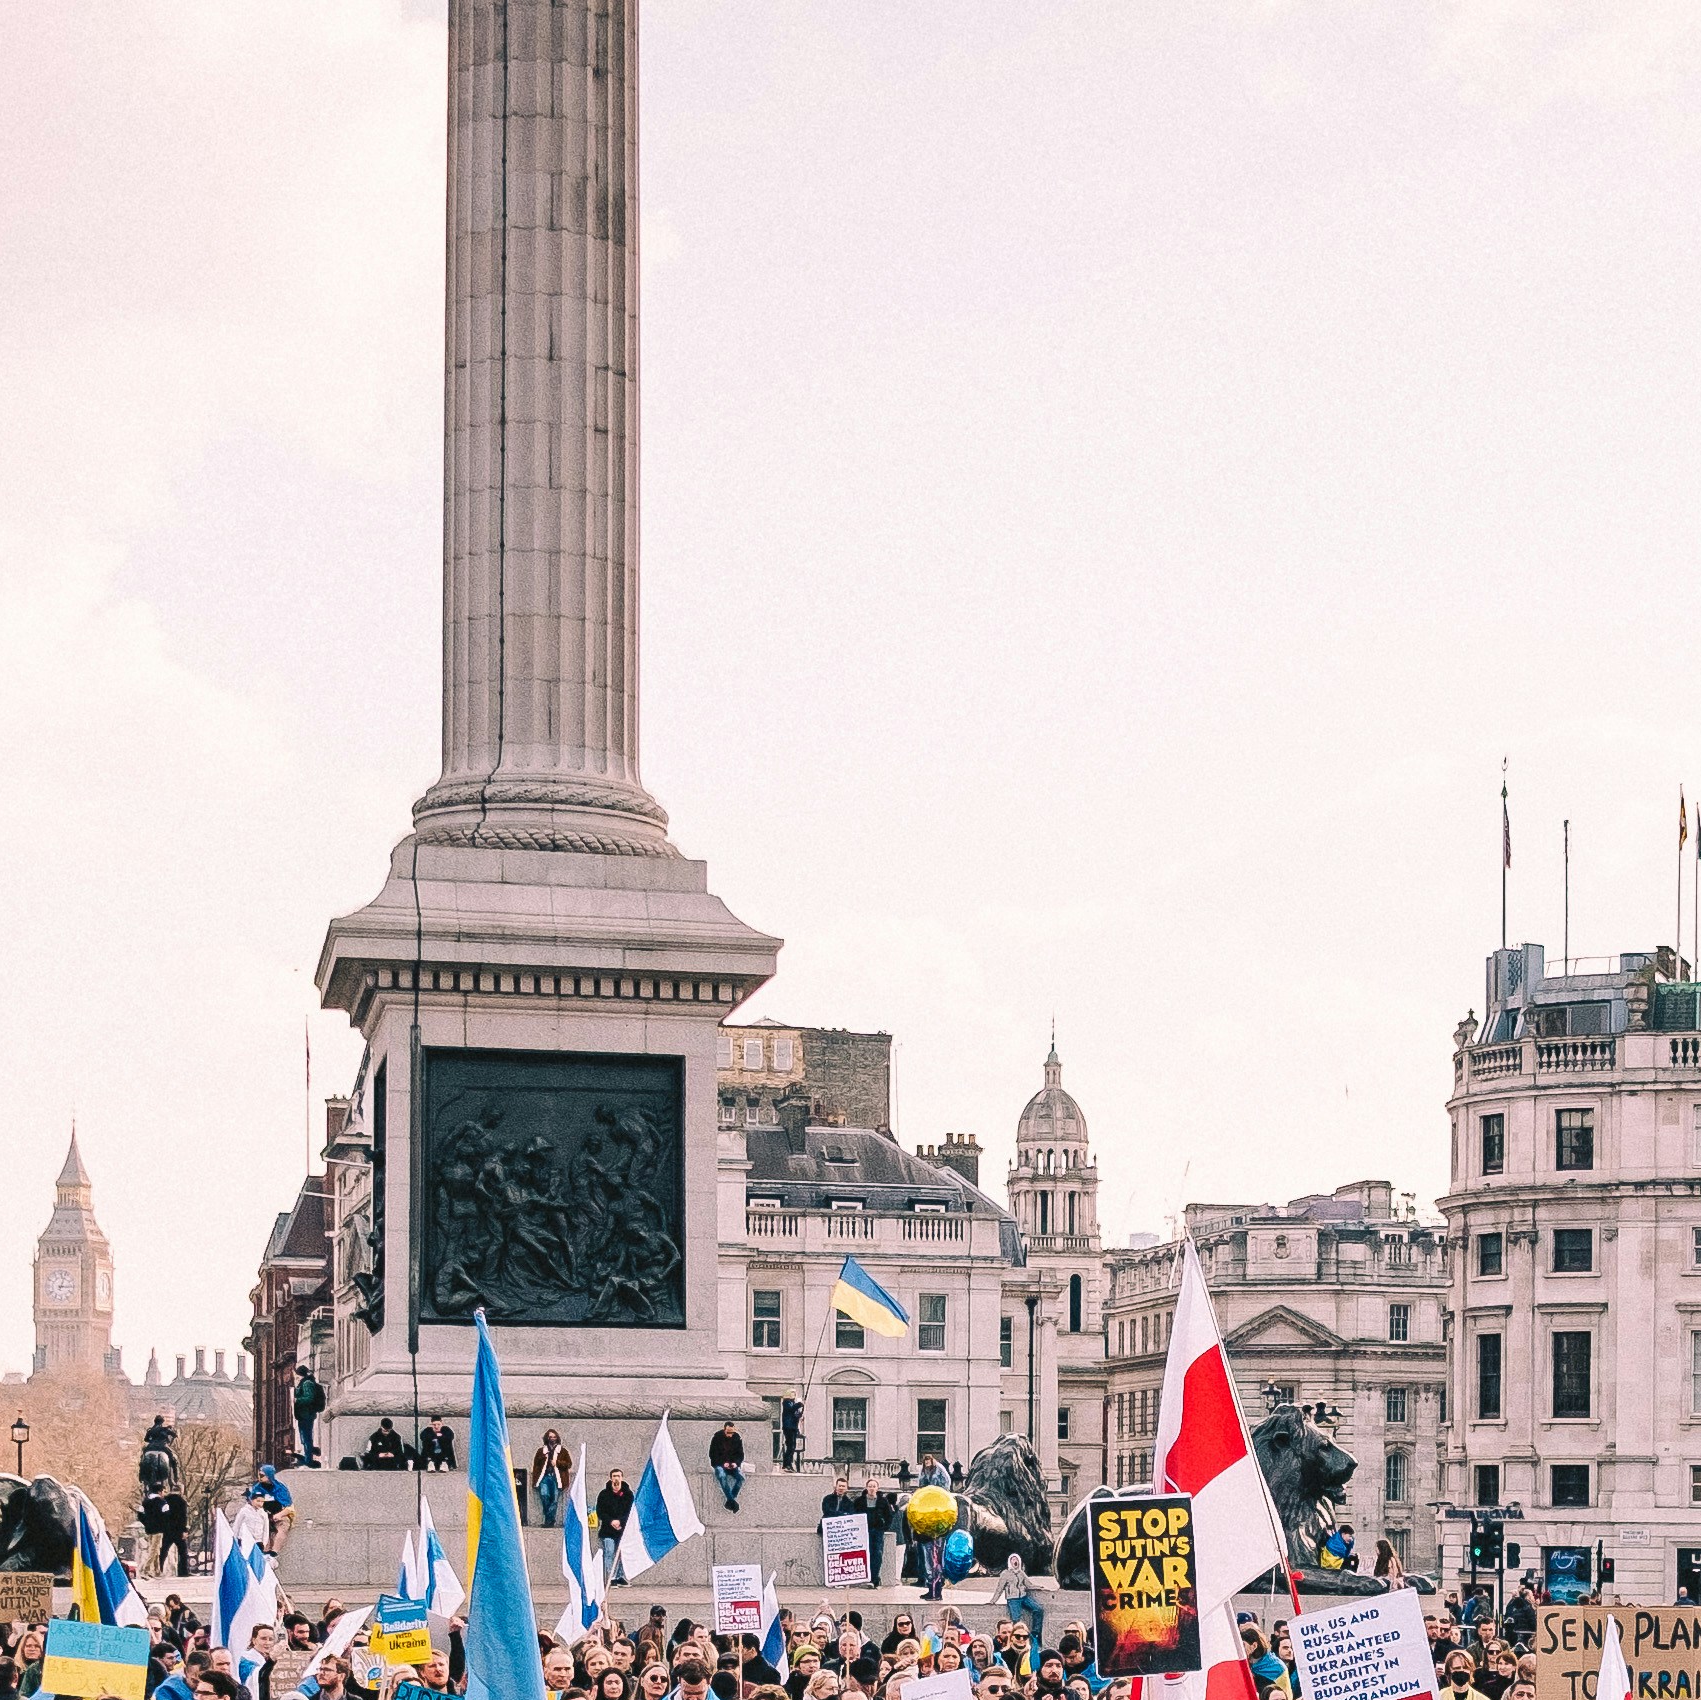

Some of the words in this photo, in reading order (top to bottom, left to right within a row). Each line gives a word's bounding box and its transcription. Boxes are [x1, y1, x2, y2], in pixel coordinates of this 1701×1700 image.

[1099, 1507, 1189, 1539] STOP
[1100, 1536, 1190, 1559] PUTIN'S
[1100, 1556, 1191, 1592] WAR
[18, 1610, 49, 1622] WAR
[1300, 1621, 1325, 1637] UK,
[1327, 1617, 1347, 1630] US
[1350, 1608, 1380, 1625] AND
[1303, 1629, 1355, 1650] RUSSIA
[1306, 1630, 1402, 1662] GUARANTEED
[1308, 1647, 1385, 1675] UKRAINE'S
[1311, 1662, 1380, 1688] SECURITY
[1384, 1657, 1400, 1669] IN
[1313, 1674, 1387, 1700] BUDAPEST
